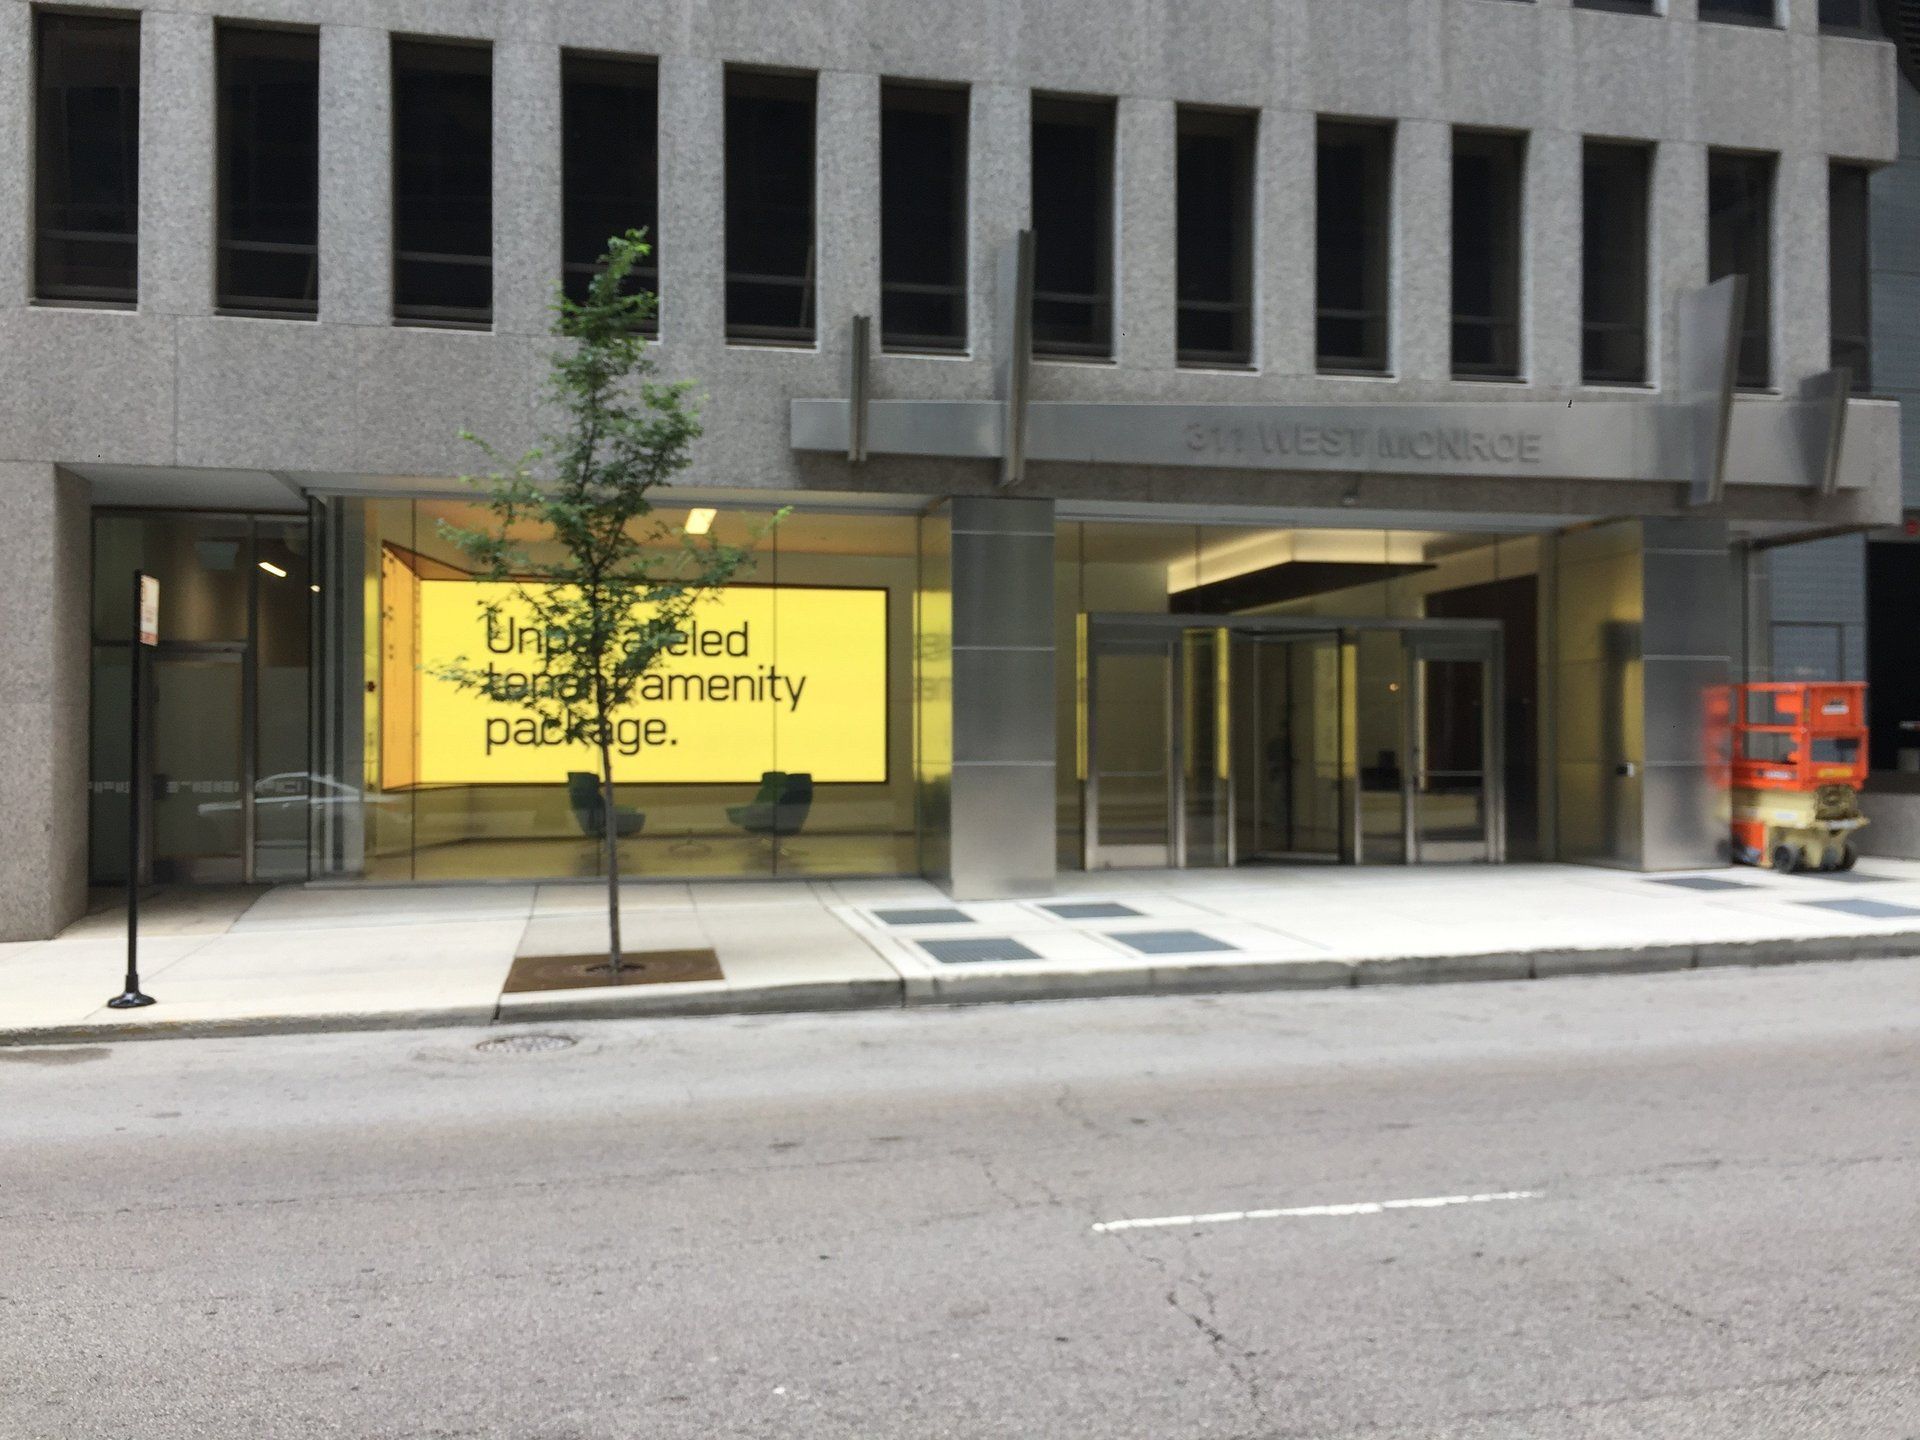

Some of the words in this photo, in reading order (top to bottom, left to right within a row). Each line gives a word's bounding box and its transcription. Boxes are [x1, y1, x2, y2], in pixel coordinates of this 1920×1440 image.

[1184, 421, 1244, 452] 311
[1258, 422, 1366, 458] WEST
[1377, 426, 1542, 464] MONROE
[641, 664, 807, 712] amenity
